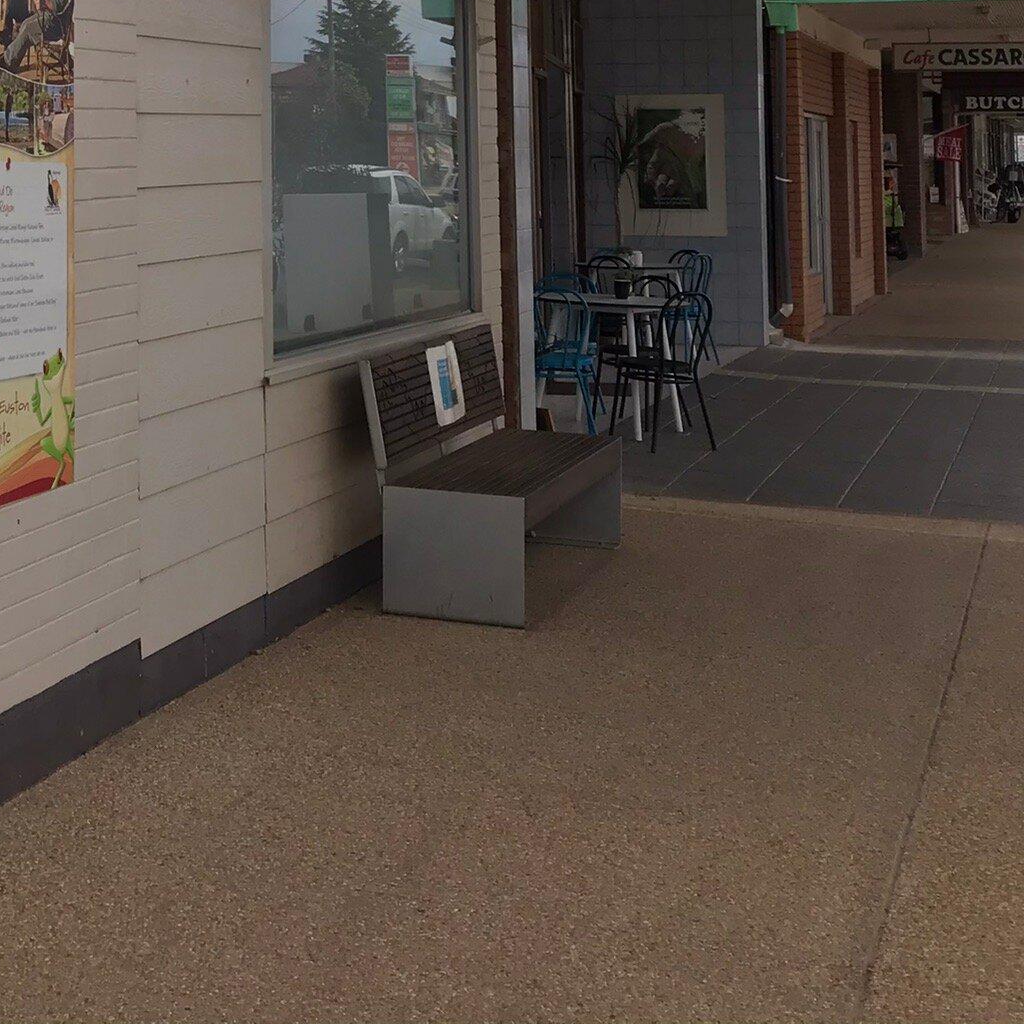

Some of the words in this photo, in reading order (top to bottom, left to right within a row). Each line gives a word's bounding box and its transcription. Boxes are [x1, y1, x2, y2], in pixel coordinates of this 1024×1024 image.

[902, 49, 935, 69] Cafe
[938, 48, 1024, 66] CASSAR
[965, 96, 1024, 110] BUTC
